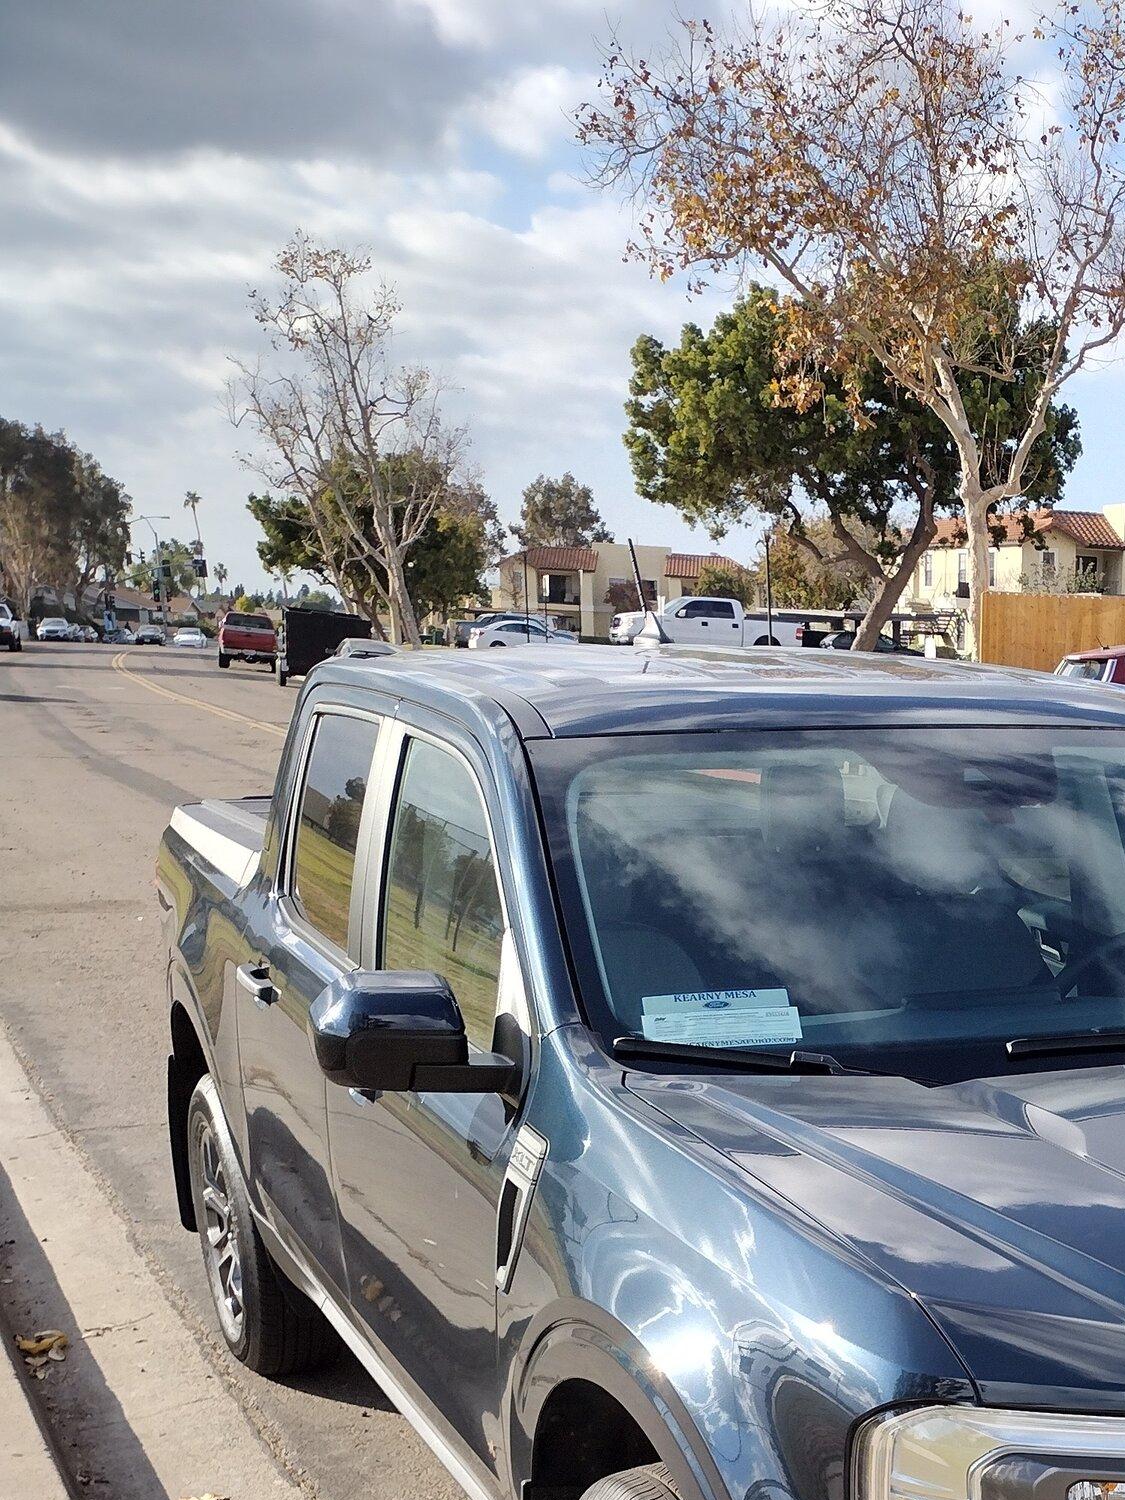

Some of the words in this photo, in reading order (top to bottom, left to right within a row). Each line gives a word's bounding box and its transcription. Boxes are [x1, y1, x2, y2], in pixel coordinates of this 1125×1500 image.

[674, 992, 721, 1003] KEARNY
[725, 990, 757, 999] MESA
[511, 1147, 535, 1172] XLT
